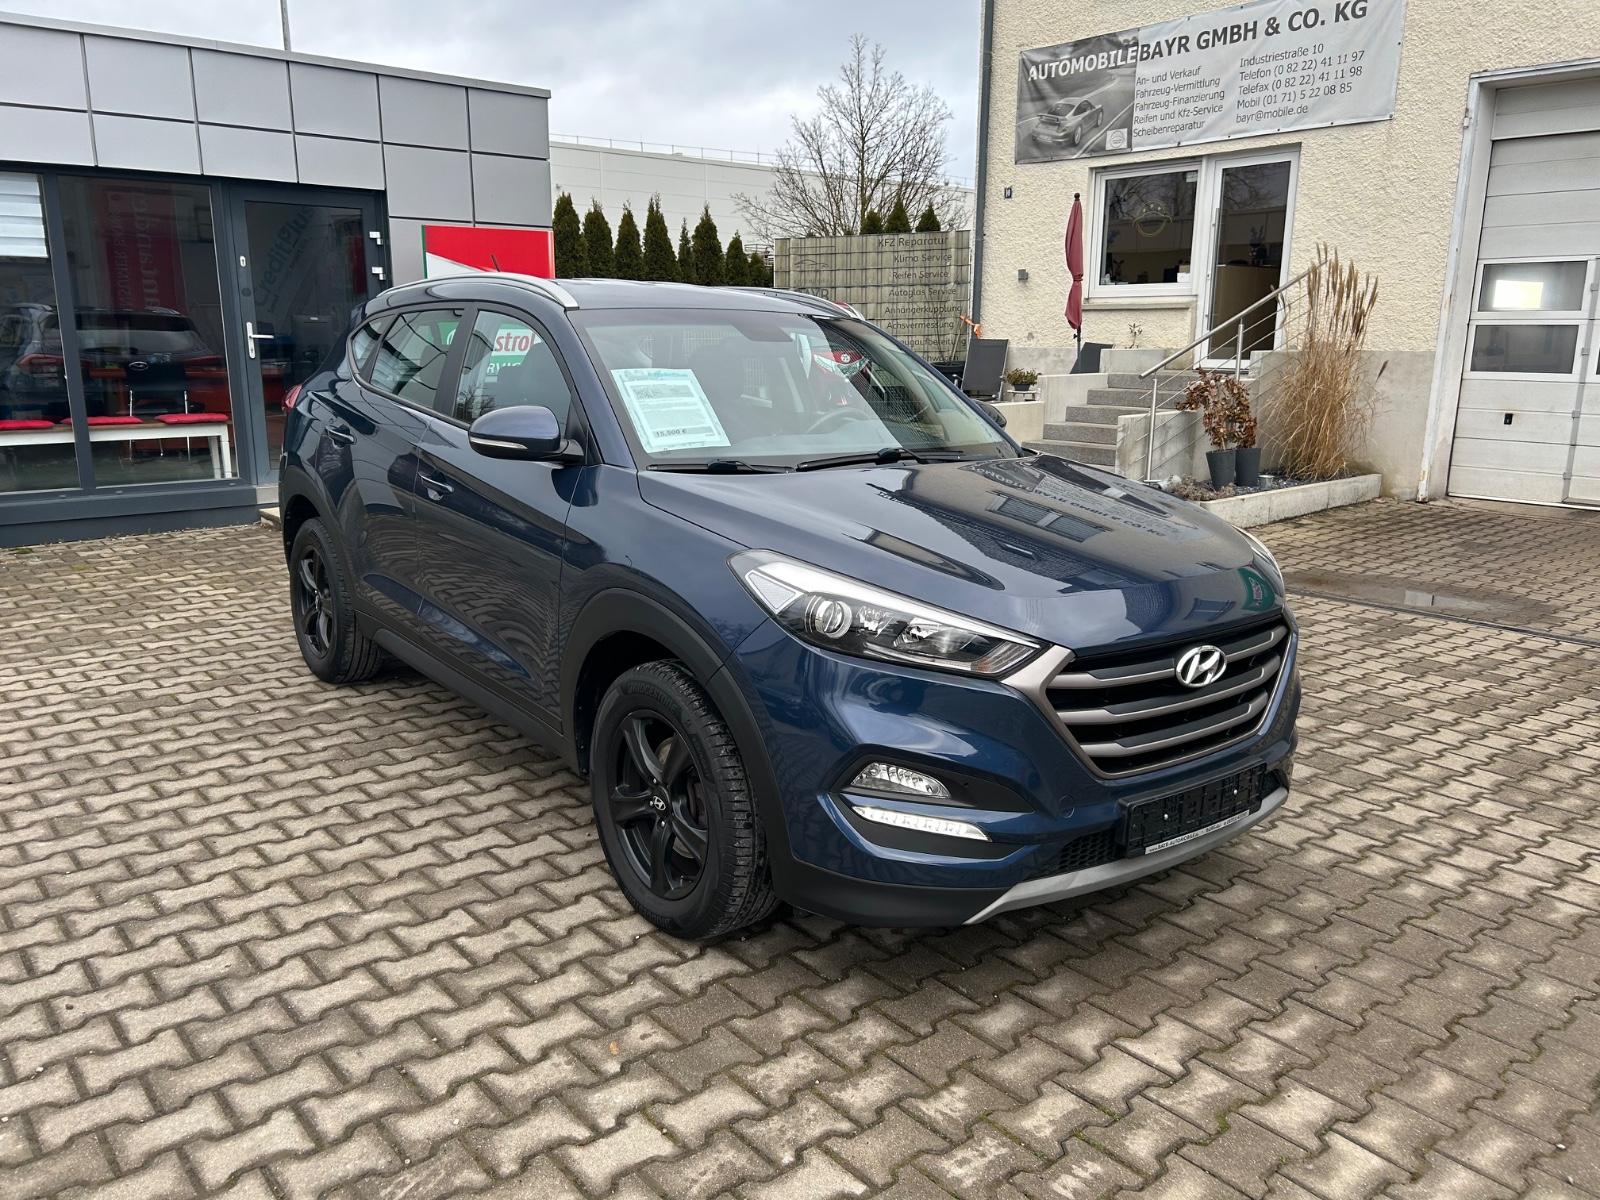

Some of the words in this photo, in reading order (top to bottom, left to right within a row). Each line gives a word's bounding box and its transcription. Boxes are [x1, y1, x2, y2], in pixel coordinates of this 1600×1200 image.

[1028, 46, 1137, 81] AUTOMOBILE
[1139, 35, 1190, 62] BAYR
[1196, 20, 1258, 50] GMBH
[1264, 16, 1280, 36] &
[1288, 8, 1325, 32] CO.
[1334, 0, 1368, 23] KG
[1239, 46, 1309, 68] Industriestraße
[1312, 43, 1324, 55] 10
[1239, 69, 1271, 81] Telefon
[1274, 64, 1284, 77] (0
[1286, 62, 1298, 73] 82
[1301, 59, 1318, 72] 22)
[1320, 56, 1333, 67] 41
[1337, 54, 1348, 65] 11
[1351, 50, 1365, 62] 97
[1151, 72, 1168, 84] und
[1169, 65, 1202, 80] Verkauf
[1238, 83, 1269, 96] Telefax
[1271, 79, 1282, 92] (0
[1284, 77, 1296, 88] 82
[1298, 74, 1316, 86] 22)
[1318, 71, 1330, 82] 41
[1334, 69, 1345, 80] 11
[1349, 66, 1363, 78] 98
[1135, 77, 1220, 99] Fahrzeug-Vermittlung
[1237, 98, 1260, 110] Mobil
[1262, 94, 1277, 107] (01
[1281, 91, 1297, 104] 71)
[1300, 89, 1306, 100] 5
[1308, 87, 1320, 99] 22
[1323, 84, 1336, 96] 08
[1339, 82, 1353, 94] 85
[1135, 90, 1225, 112] Fahrzeug-Finanzierung
[1134, 113, 1158, 125] Reifen
[1160, 110, 1175, 121] und
[1177, 103, 1224, 118] Kfz-Service
[1236, 104, 1309, 124] bayr@mobile.de
[1133, 120, 1205, 138] Scheibenreparatur
[878, 238, 896, 247] KFZ
[898, 236, 949, 247] Reparatur
[921, 253, 952, 262] Service
[892, 271, 917, 280] Reifen
[919, 270, 949, 279] Service
[888, 289, 925, 298] Autoglas
[928, 287, 957, 296] Service
[886, 320, 954, 330] Achsvermessung
[495, 332, 535, 351] strol
